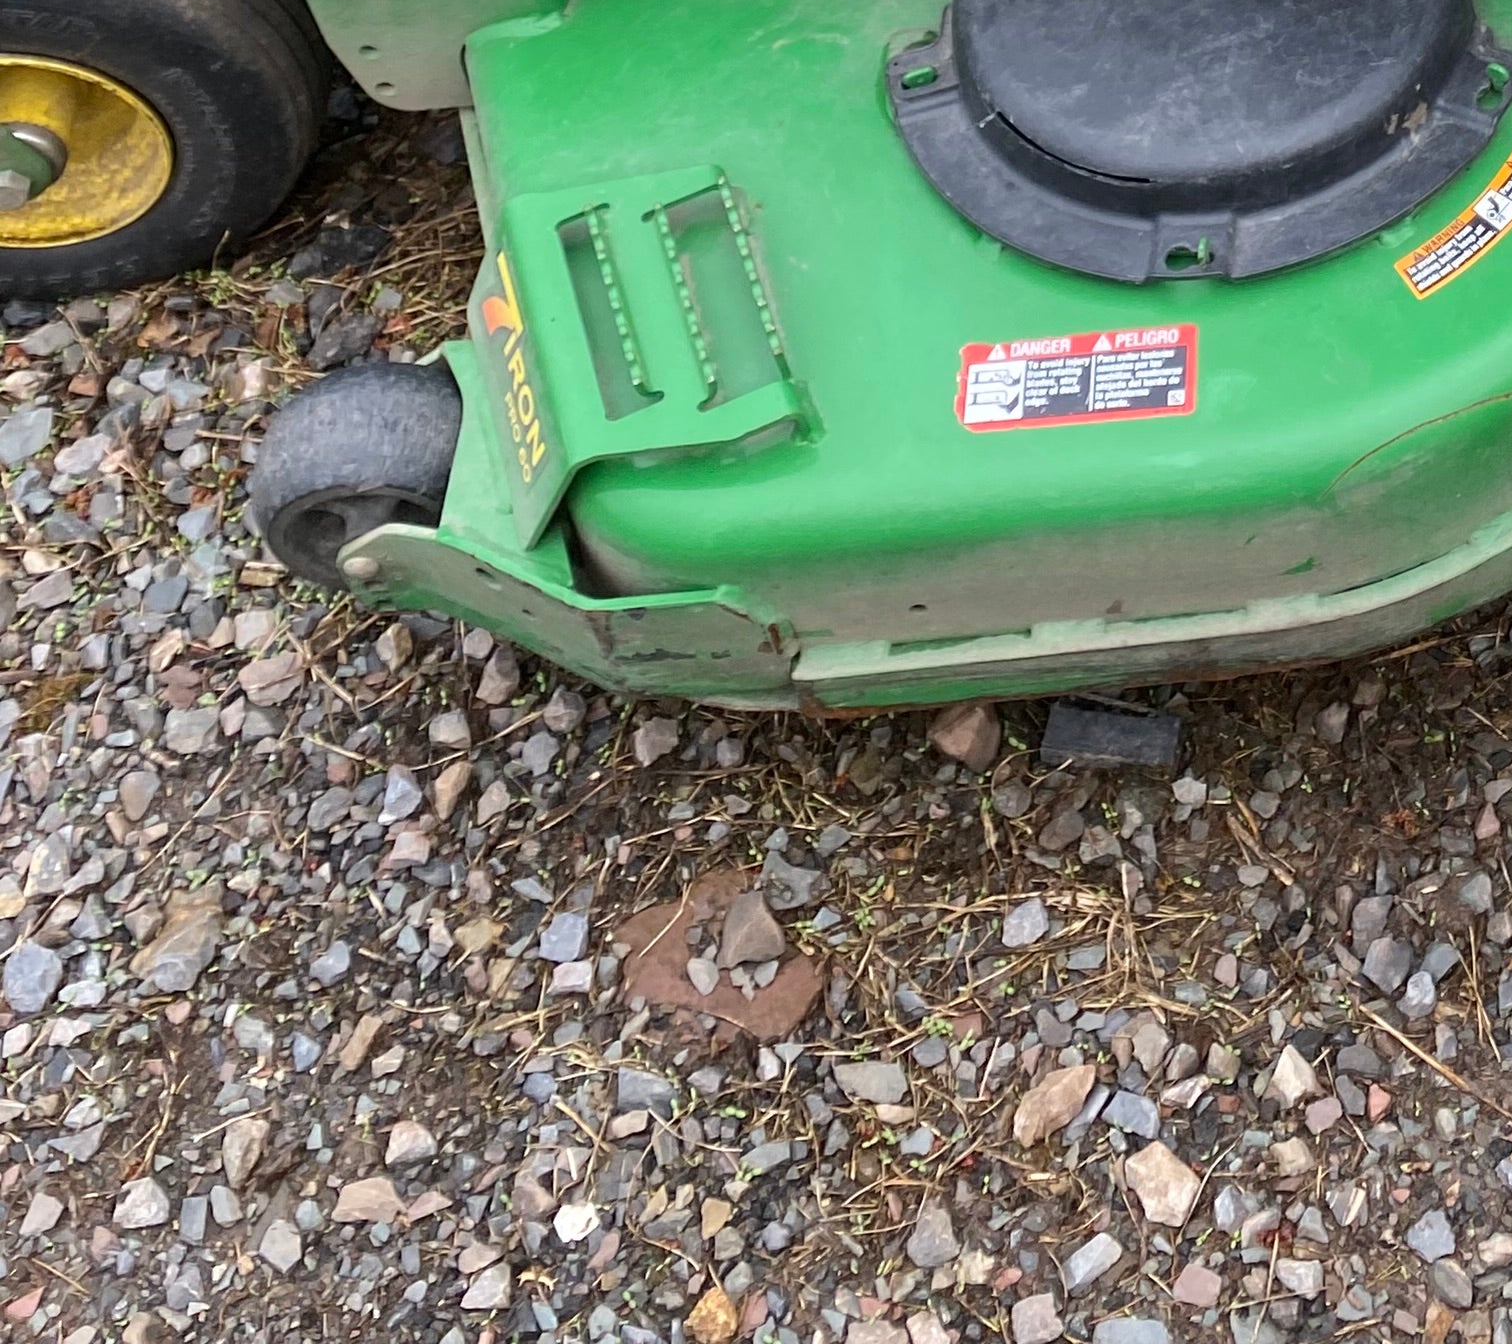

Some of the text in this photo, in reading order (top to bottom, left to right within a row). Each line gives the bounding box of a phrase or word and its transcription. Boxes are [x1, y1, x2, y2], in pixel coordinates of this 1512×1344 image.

[1421, 218, 1466, 254] WARNING
[1009, 338, 1071, 359] DANGER
[1115, 329, 1179, 348] PELIGRO
